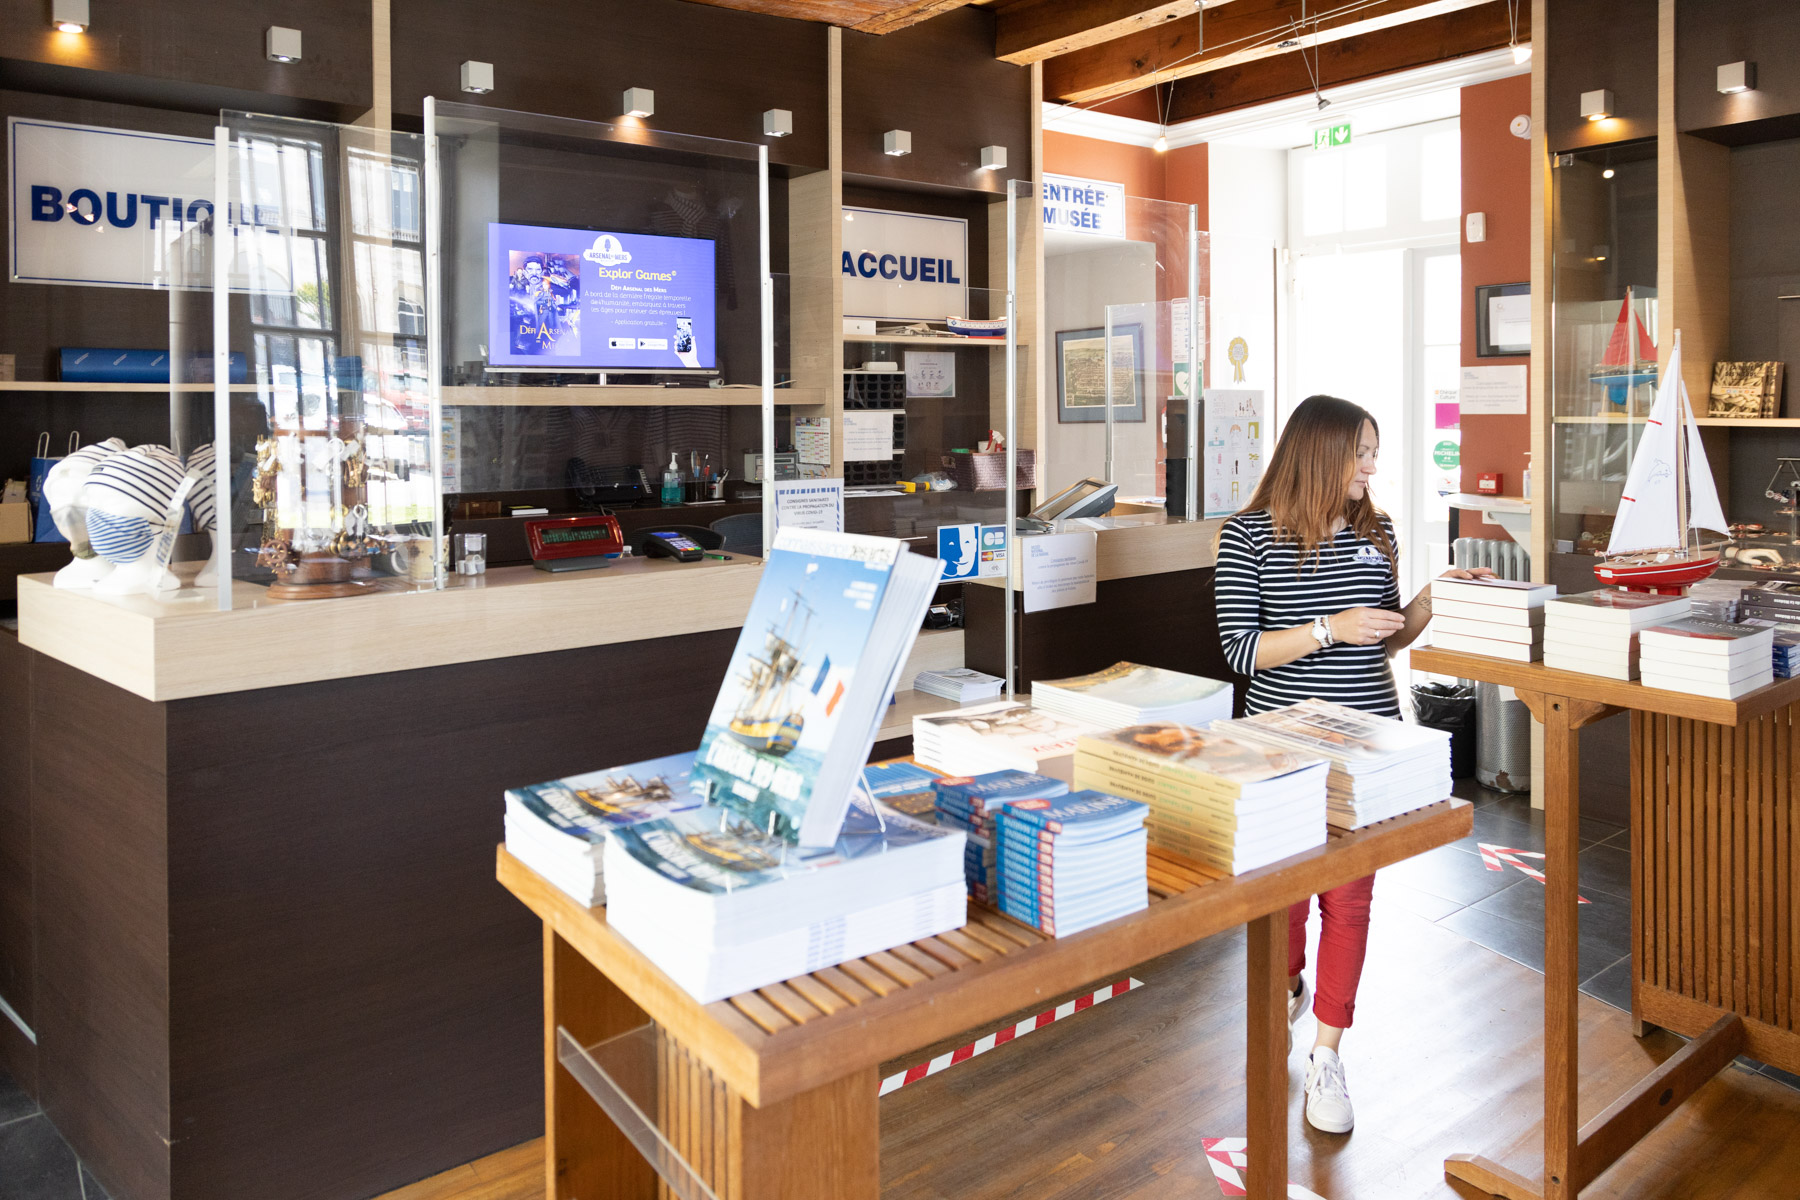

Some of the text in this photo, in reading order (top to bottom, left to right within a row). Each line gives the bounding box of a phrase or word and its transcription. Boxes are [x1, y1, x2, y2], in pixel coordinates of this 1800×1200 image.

[1043, 207, 1101, 229] MUSÉE
[599, 267, 633, 280] Explor
[842, 250, 960, 284] ACCUEIL
